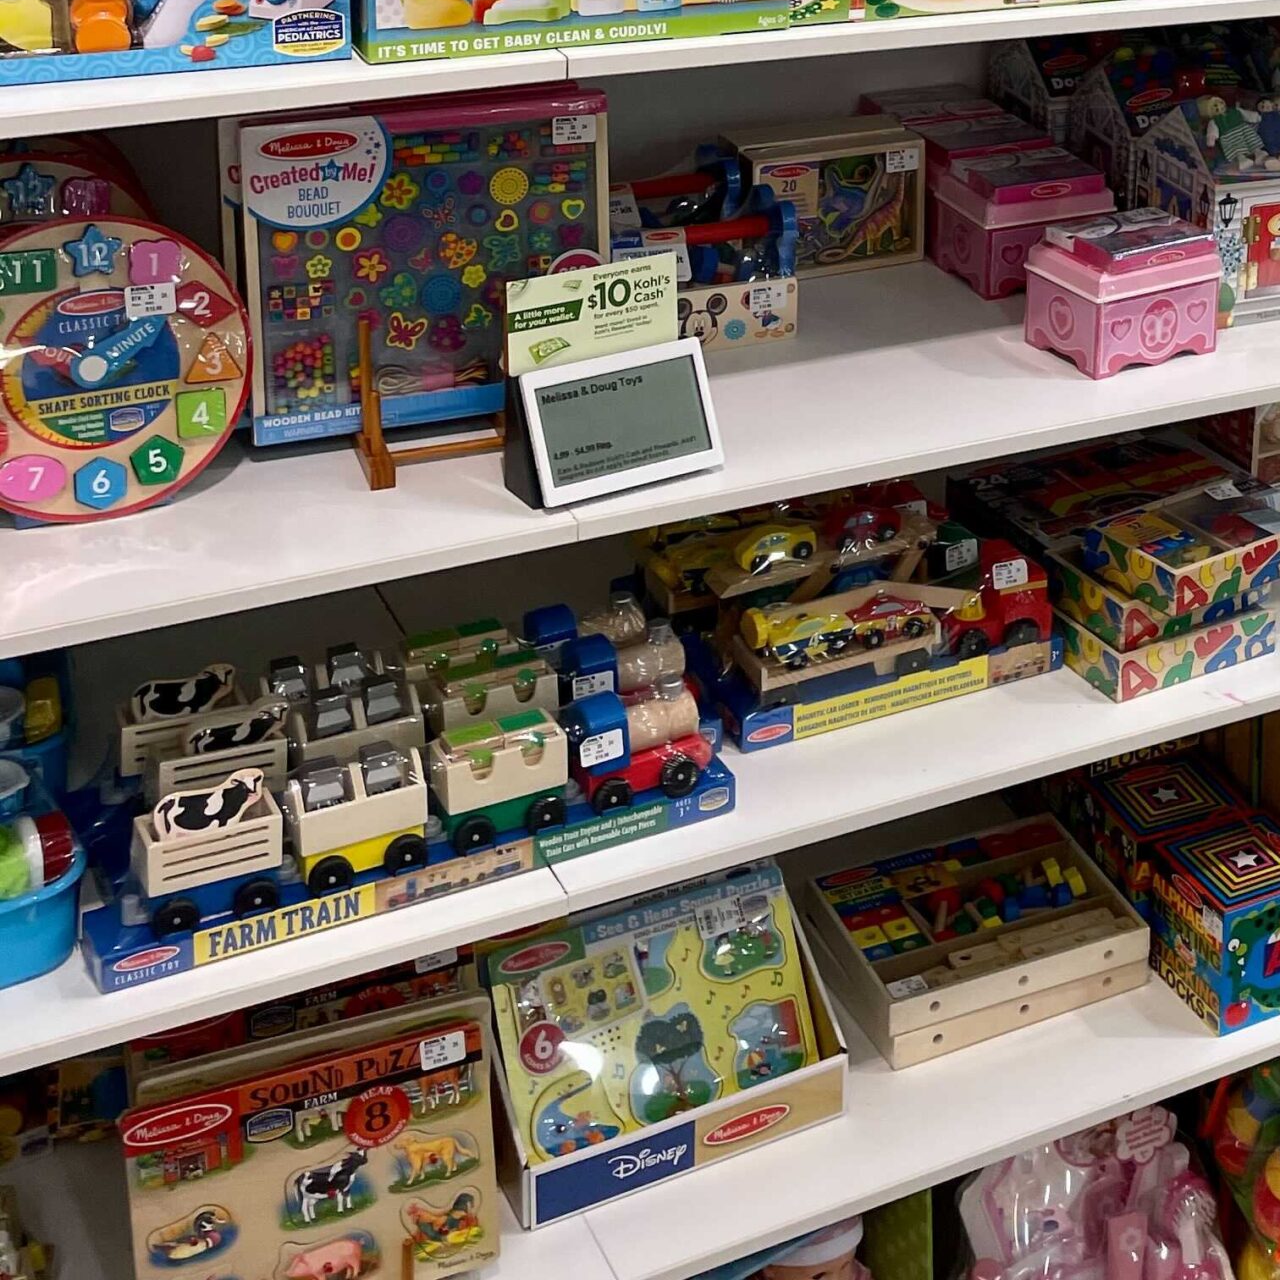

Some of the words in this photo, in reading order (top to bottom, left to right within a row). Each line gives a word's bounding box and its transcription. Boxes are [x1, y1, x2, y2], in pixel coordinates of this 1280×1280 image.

[278, 29, 341, 42] PEDIATRICS
[378, 45, 408, 59] IT'S
[410, 41, 446, 56] TIME
[449, 38, 469, 53] TO
[473, 36, 501, 51] GET
[504, 32, 543, 48] BABY
[545, 28, 591, 43] CLEAN
[608, 23, 668, 39] CUDDLY!
[268, 139, 314, 154] Melissa
[324, 136, 351, 151] Doug
[250, 165, 321, 196] Created
[341, 162, 376, 183] Me!
[782, 178, 797, 194] 20
[298, 185, 329, 203] BEAD
[286, 201, 342, 220] BOUQUET
[79, 242, 109, 268] 12
[593, 268, 629, 282] Everyone
[587, 277, 631, 311] $10
[633, 274, 671, 291] Kohl's
[633, 290, 664, 304] Cash
[59, 315, 111, 334] CLASSIC
[523, 309, 542, 320] little
[544, 306, 566, 316] more
[527, 317, 548, 329] your
[105, 322, 156, 360] MINUTE
[590, 379, 618, 395] Doug
[618, 374, 644, 389] Toys
[38, 400, 76, 416] SHAPE
[79, 391, 132, 408] SORTING
[134, 384, 171, 401] CLOCK
[190, 401, 209, 425] 4
[262, 410, 312, 429] WOODEN
[313, 408, 342, 423] BEAD
[344, 406, 362, 421] KIT
[148, 448, 168, 474] 5
[27, 466, 46, 492] 7
[622, 823, 638, 836] Cargo
[597, 922, 624, 938] See
[643, 906, 676, 926] Hear
[726, 875, 771, 897] Puzzle
[208, 915, 278, 959] FARM
[281, 891, 362, 936] TRAIN
[114, 966, 158, 986] CLASSIC
[161, 959, 181, 972] TOY
[1150, 952, 1207, 1020] BLOCKS
[248, 1065, 345, 1112] SOUND
[303, 1091, 338, 1110] FARM
[359, 1085, 394, 1104] HEAR
[364, 1100, 390, 1132] 8
[608, 1144, 688, 1180] Disney
